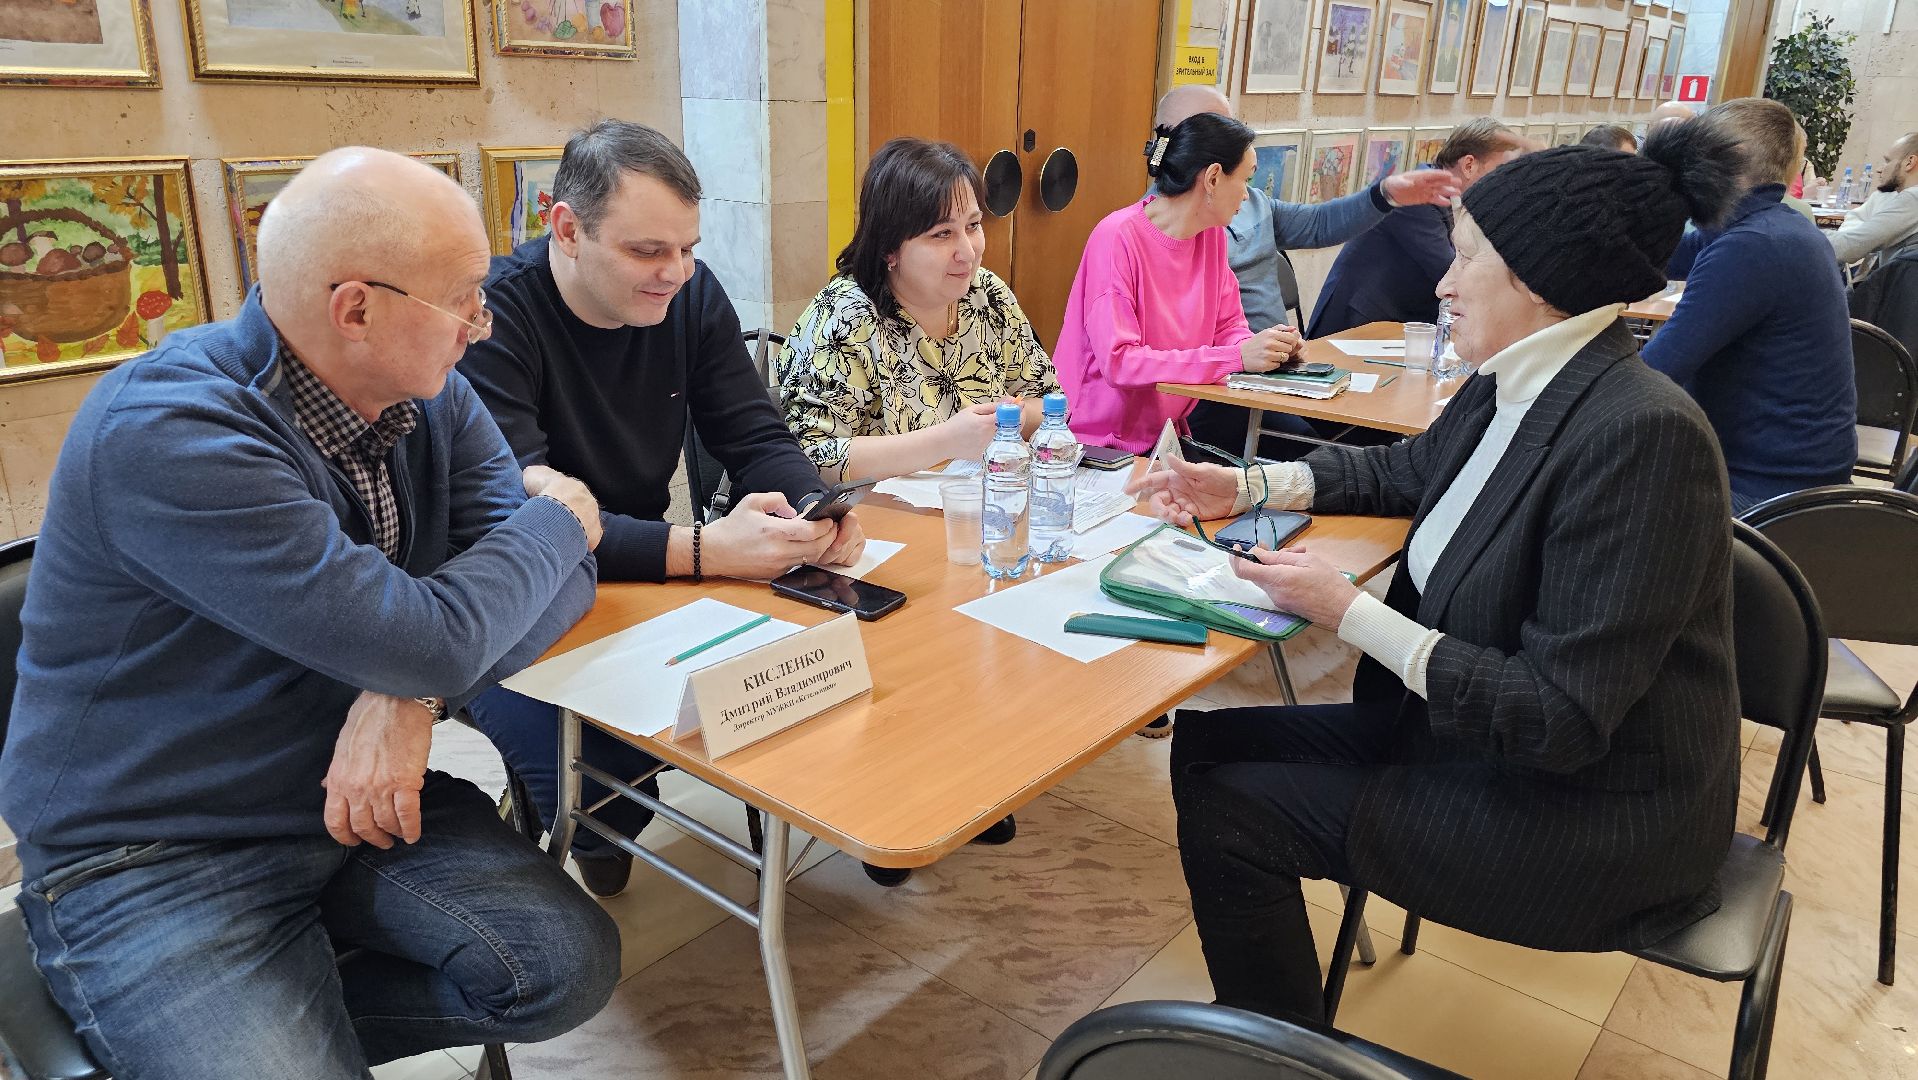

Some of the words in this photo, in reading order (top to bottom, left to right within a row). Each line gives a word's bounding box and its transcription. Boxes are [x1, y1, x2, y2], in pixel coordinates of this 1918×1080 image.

[1188, 55, 1201, 65] ВХОД
[1205, 68, 1215, 76] ЗАЛ
[743, 648, 825, 693] КИСЛЕНКО
[720, 691, 774, 725] Дмитрий
[774, 660, 852, 700] Владимирович
[733, 714, 765, 733] Директор
